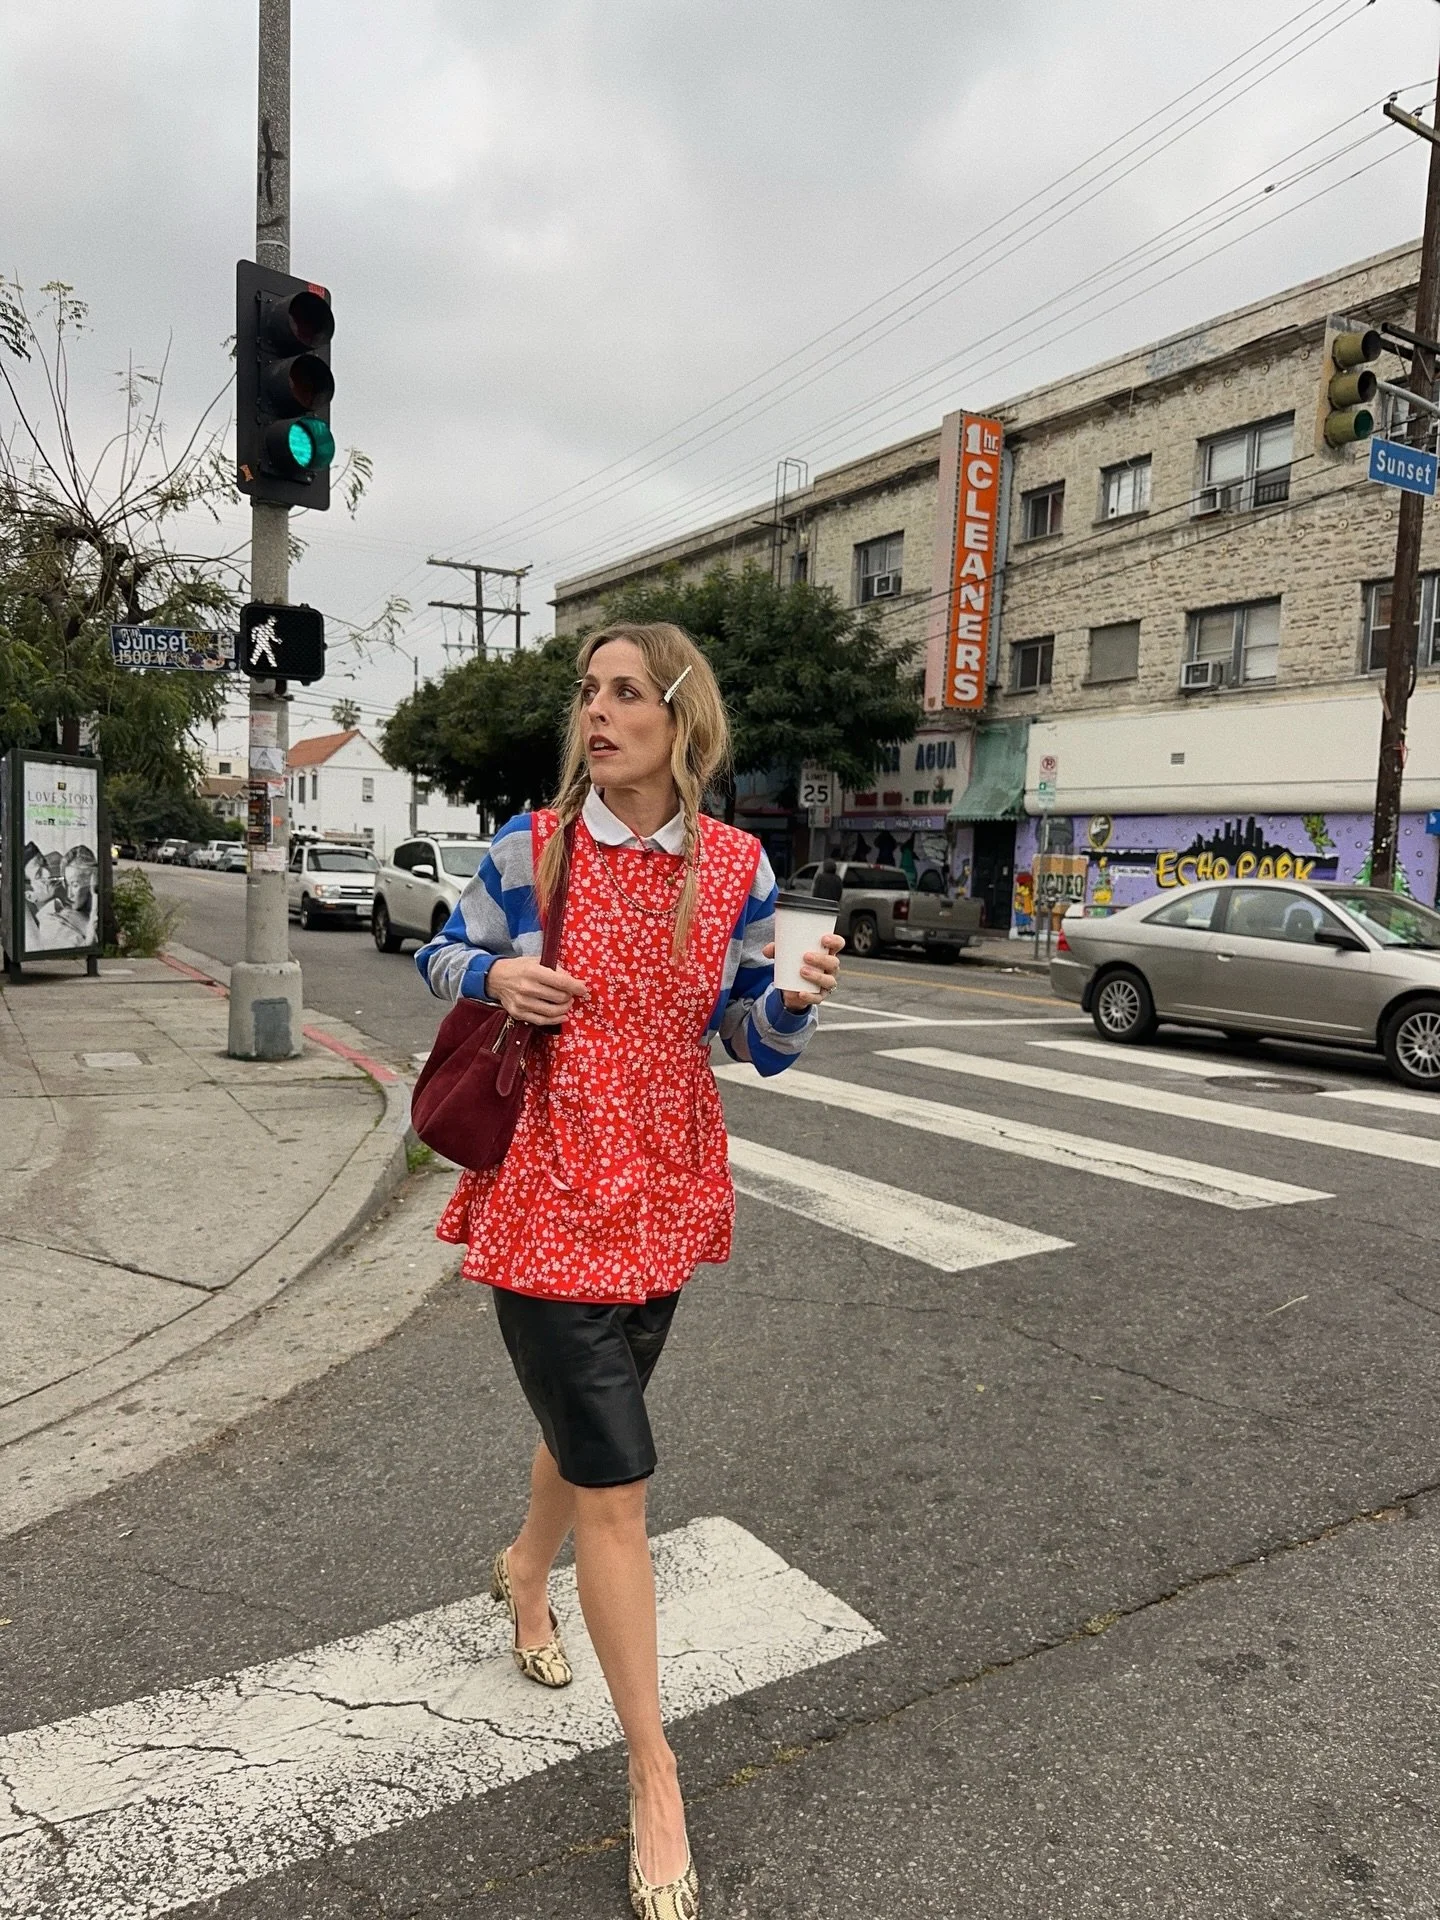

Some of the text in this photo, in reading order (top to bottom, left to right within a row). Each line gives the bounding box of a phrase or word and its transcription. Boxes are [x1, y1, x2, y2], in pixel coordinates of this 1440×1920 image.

[1376, 449, 1431, 485] Sunset
[953, 459, 993, 702] CLEANERS
[118, 628, 189, 652] Sunset
[119, 651, 167, 666] 1500 W
[915, 740, 956, 771] AGUA
[805, 773, 828, 781] LIMIT
[27, 791, 95, 806] LOVE STORY
[804, 784, 828, 803] 25
[1155, 850, 1317, 888] ECHO PARK
